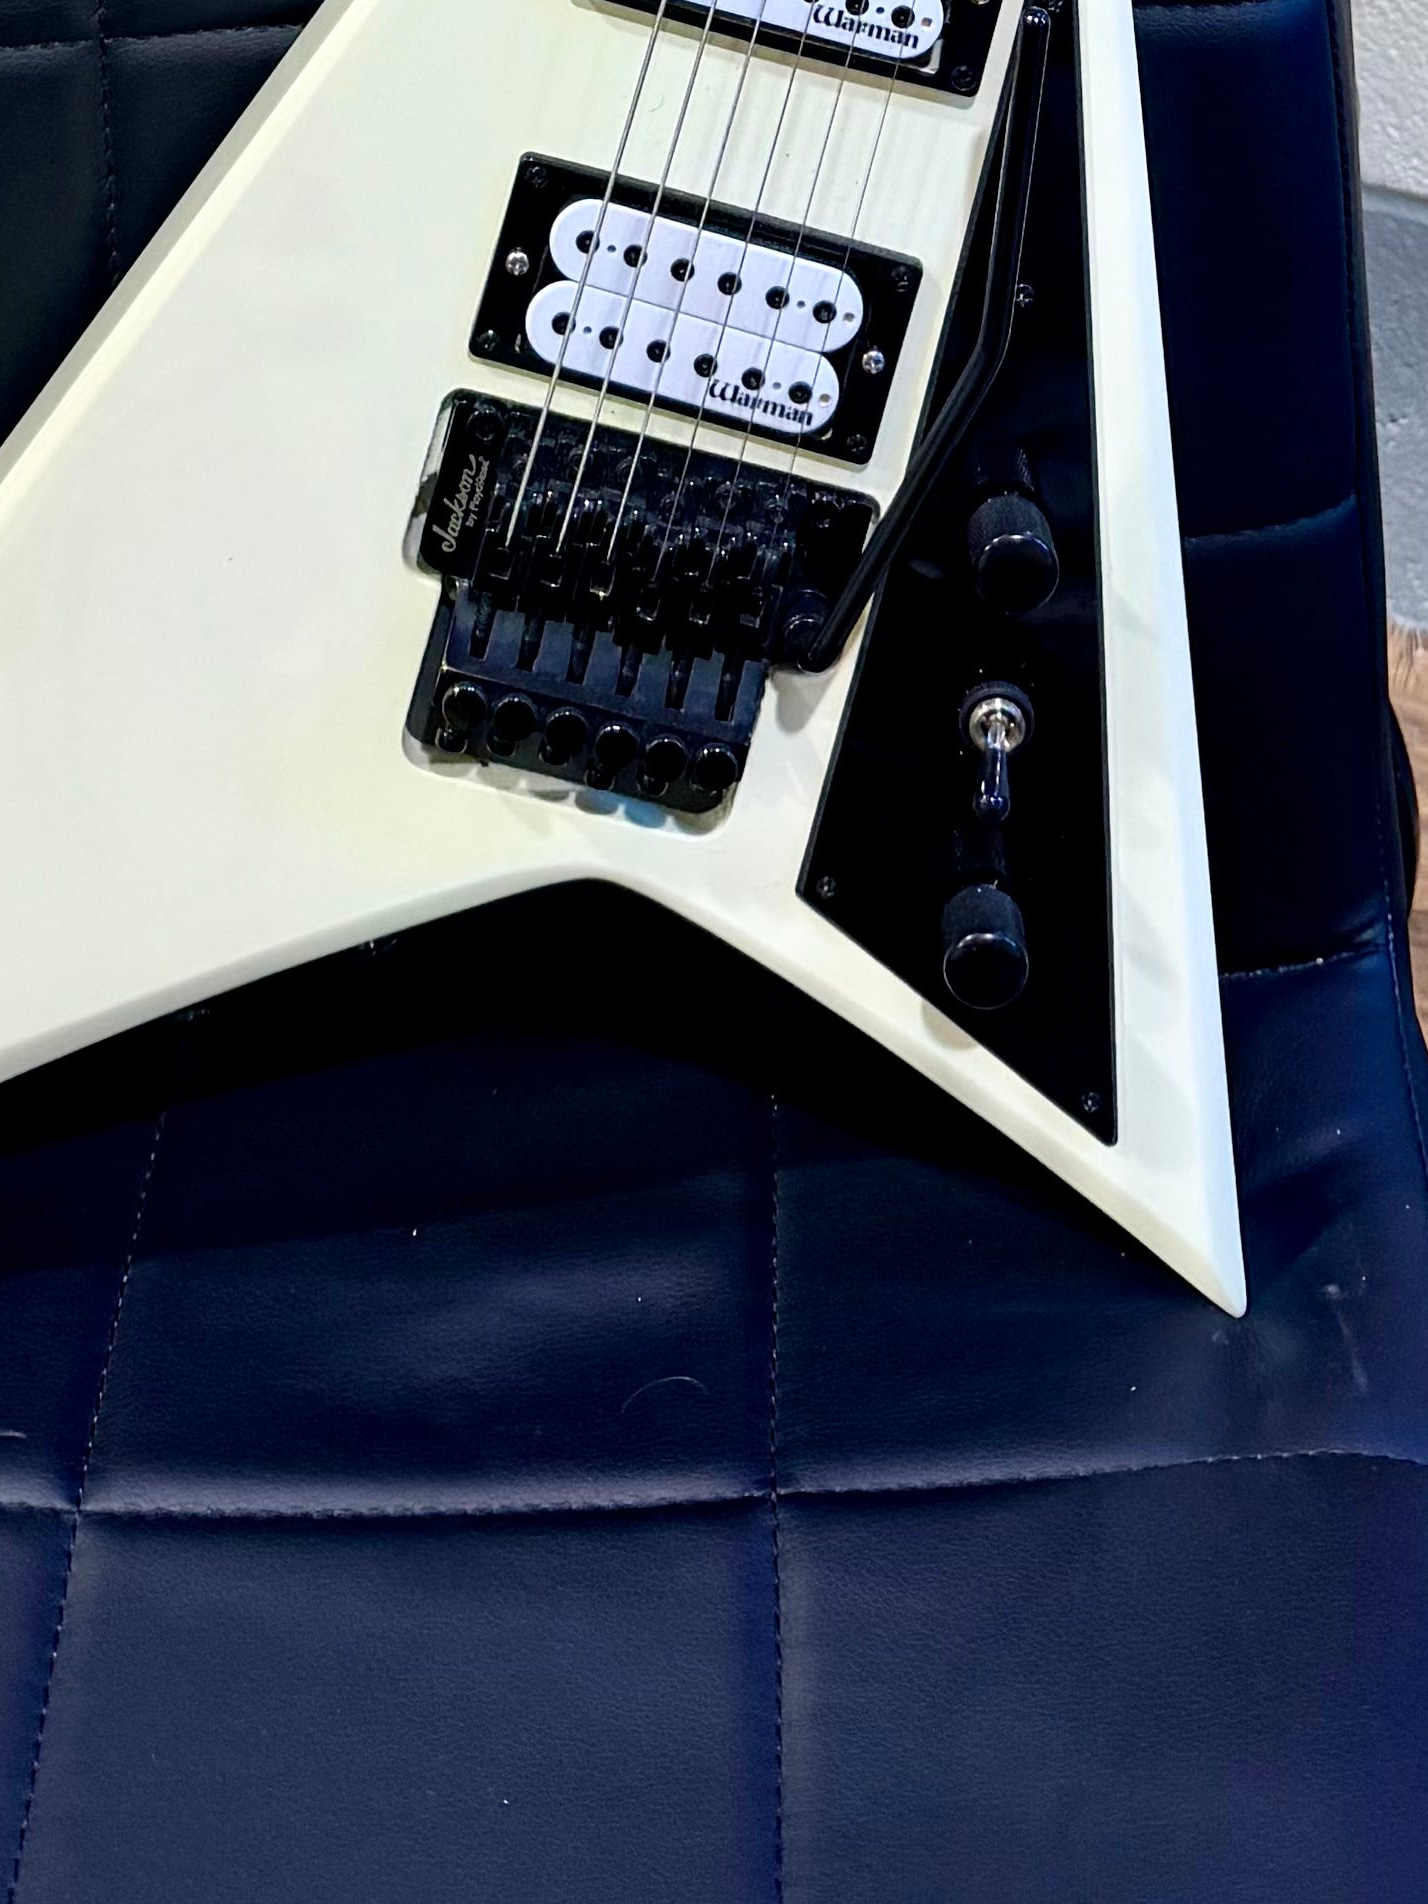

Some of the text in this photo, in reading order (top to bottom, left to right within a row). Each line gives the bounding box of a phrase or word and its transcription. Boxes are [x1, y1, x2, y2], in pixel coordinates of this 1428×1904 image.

[812, 4, 920, 50] Warman
[708, 379, 814, 427] Warman
[432, 454, 477, 553] Jackson
